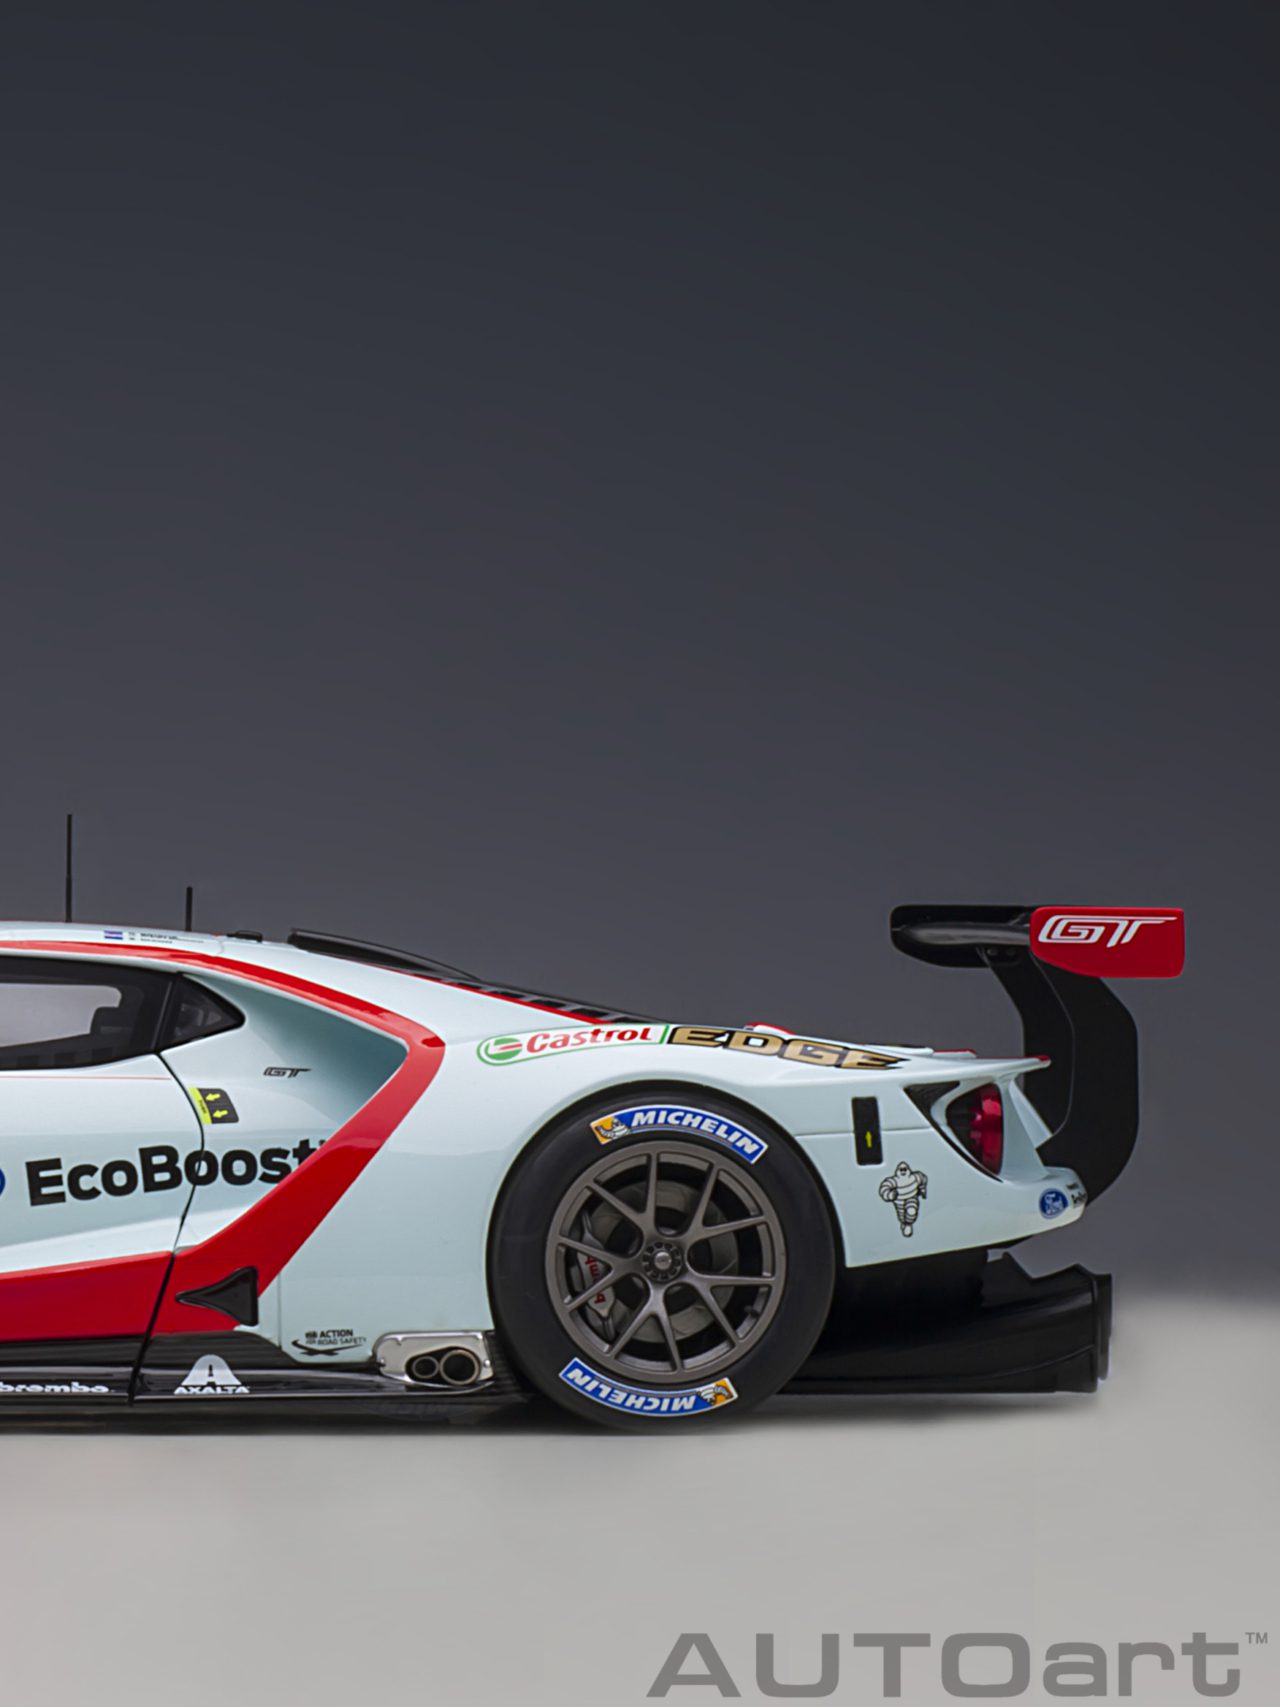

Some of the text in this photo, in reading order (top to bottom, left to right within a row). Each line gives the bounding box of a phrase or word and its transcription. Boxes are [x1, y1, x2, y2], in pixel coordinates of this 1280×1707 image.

[1038, 915, 1177, 947] GT
[526, 1026, 910, 1070] Castrol EDGE
[263, 1067, 312, 1078] GT
[631, 1110, 759, 1155] MICHELIN
[174, 1386, 248, 1394] AXALTA
[567, 1368, 696, 1411] MICHELIN
